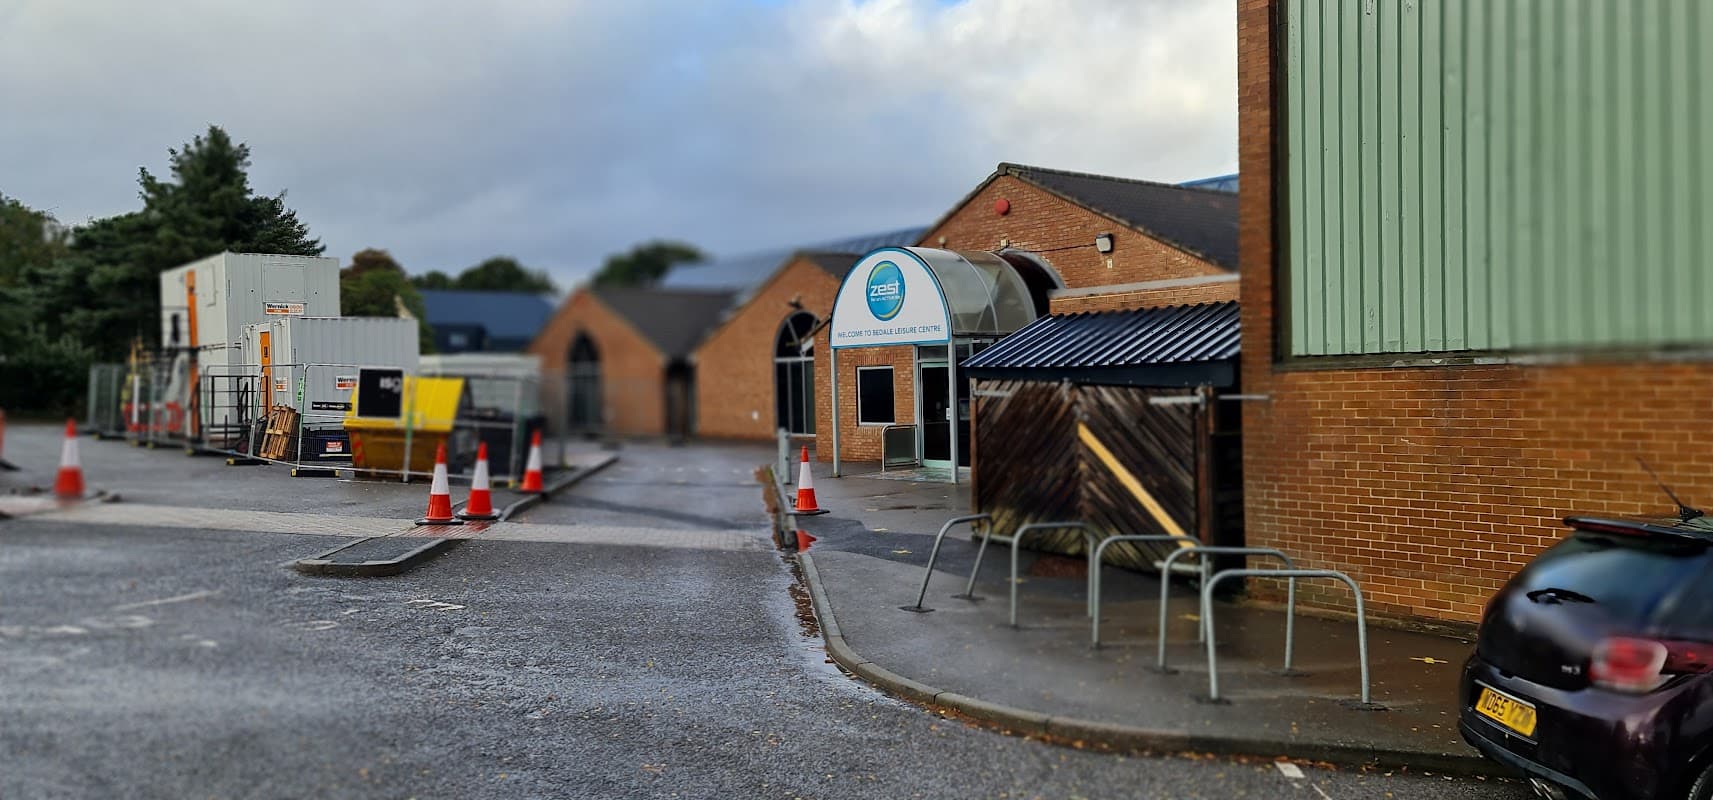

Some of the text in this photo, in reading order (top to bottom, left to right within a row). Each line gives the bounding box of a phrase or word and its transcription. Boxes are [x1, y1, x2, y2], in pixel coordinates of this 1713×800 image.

[870, 280, 900, 296] zest
[864, 329, 872, 337] TO
[872, 328, 893, 336] BEDALE
[894, 326, 917, 335] LEISURE
[918, 324, 941, 333] CENTRE
